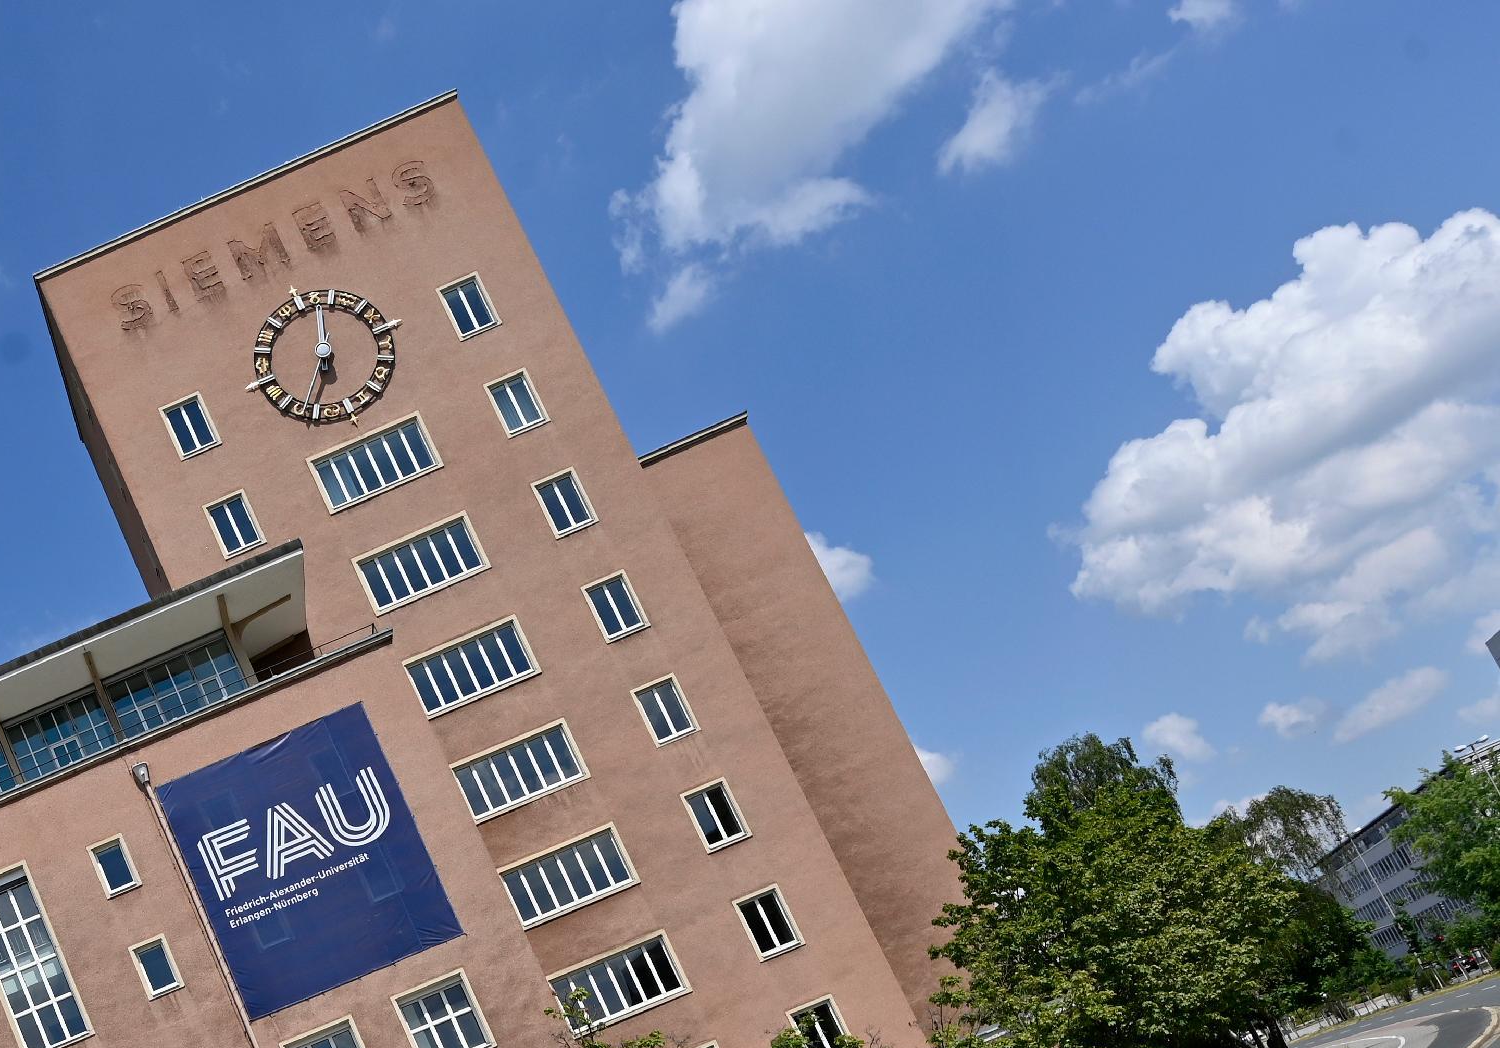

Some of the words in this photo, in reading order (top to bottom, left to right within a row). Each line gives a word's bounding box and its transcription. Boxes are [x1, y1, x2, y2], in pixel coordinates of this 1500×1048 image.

[111, 160, 437, 331] SIEMENS
[197, 766, 390, 901] FAU
[225, 852, 369, 918] Friedrich-Alexander-Universität
[229, 887, 319, 928] Erlangen-Nürnberg
